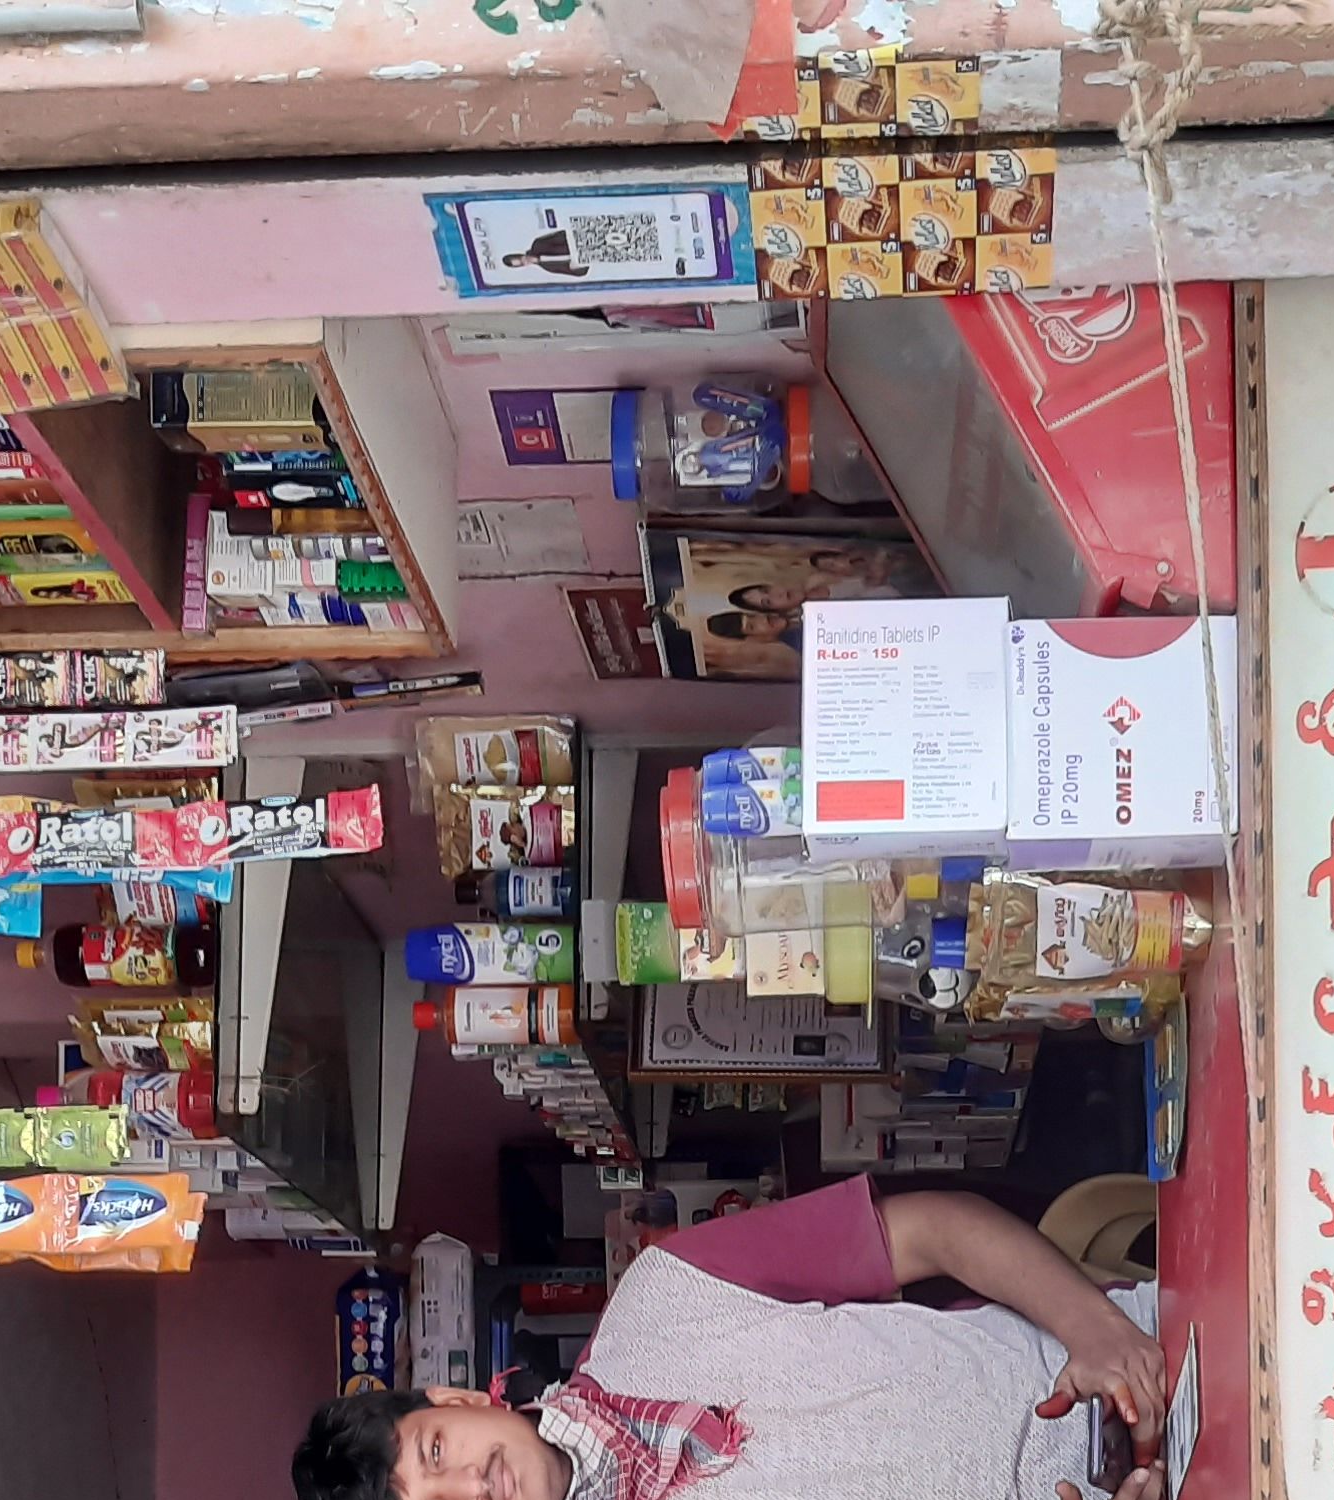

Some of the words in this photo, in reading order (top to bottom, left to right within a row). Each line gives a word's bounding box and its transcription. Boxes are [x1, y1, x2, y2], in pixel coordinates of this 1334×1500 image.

[816, 628, 878, 644] Ranitidine
[880, 625, 927, 643] Tablets
[928, 624, 941, 642] IP
[873, 647, 899, 659] 150
[1032, 641, 1052, 717] Capsules
[1032, 722, 1052, 826] Omeprazole
[1062, 754, 1083, 804] 20mg
[1115, 747, 1132, 826] OMEZ
[227, 797, 327, 834] Ratol
[737, 794, 755, 829] nycil
[1062, 808, 1079, 825] IP
[1192, 790, 1205, 823] 20mg
[438, 933, 456, 974] nycil
[539, 933, 559, 949] 5
